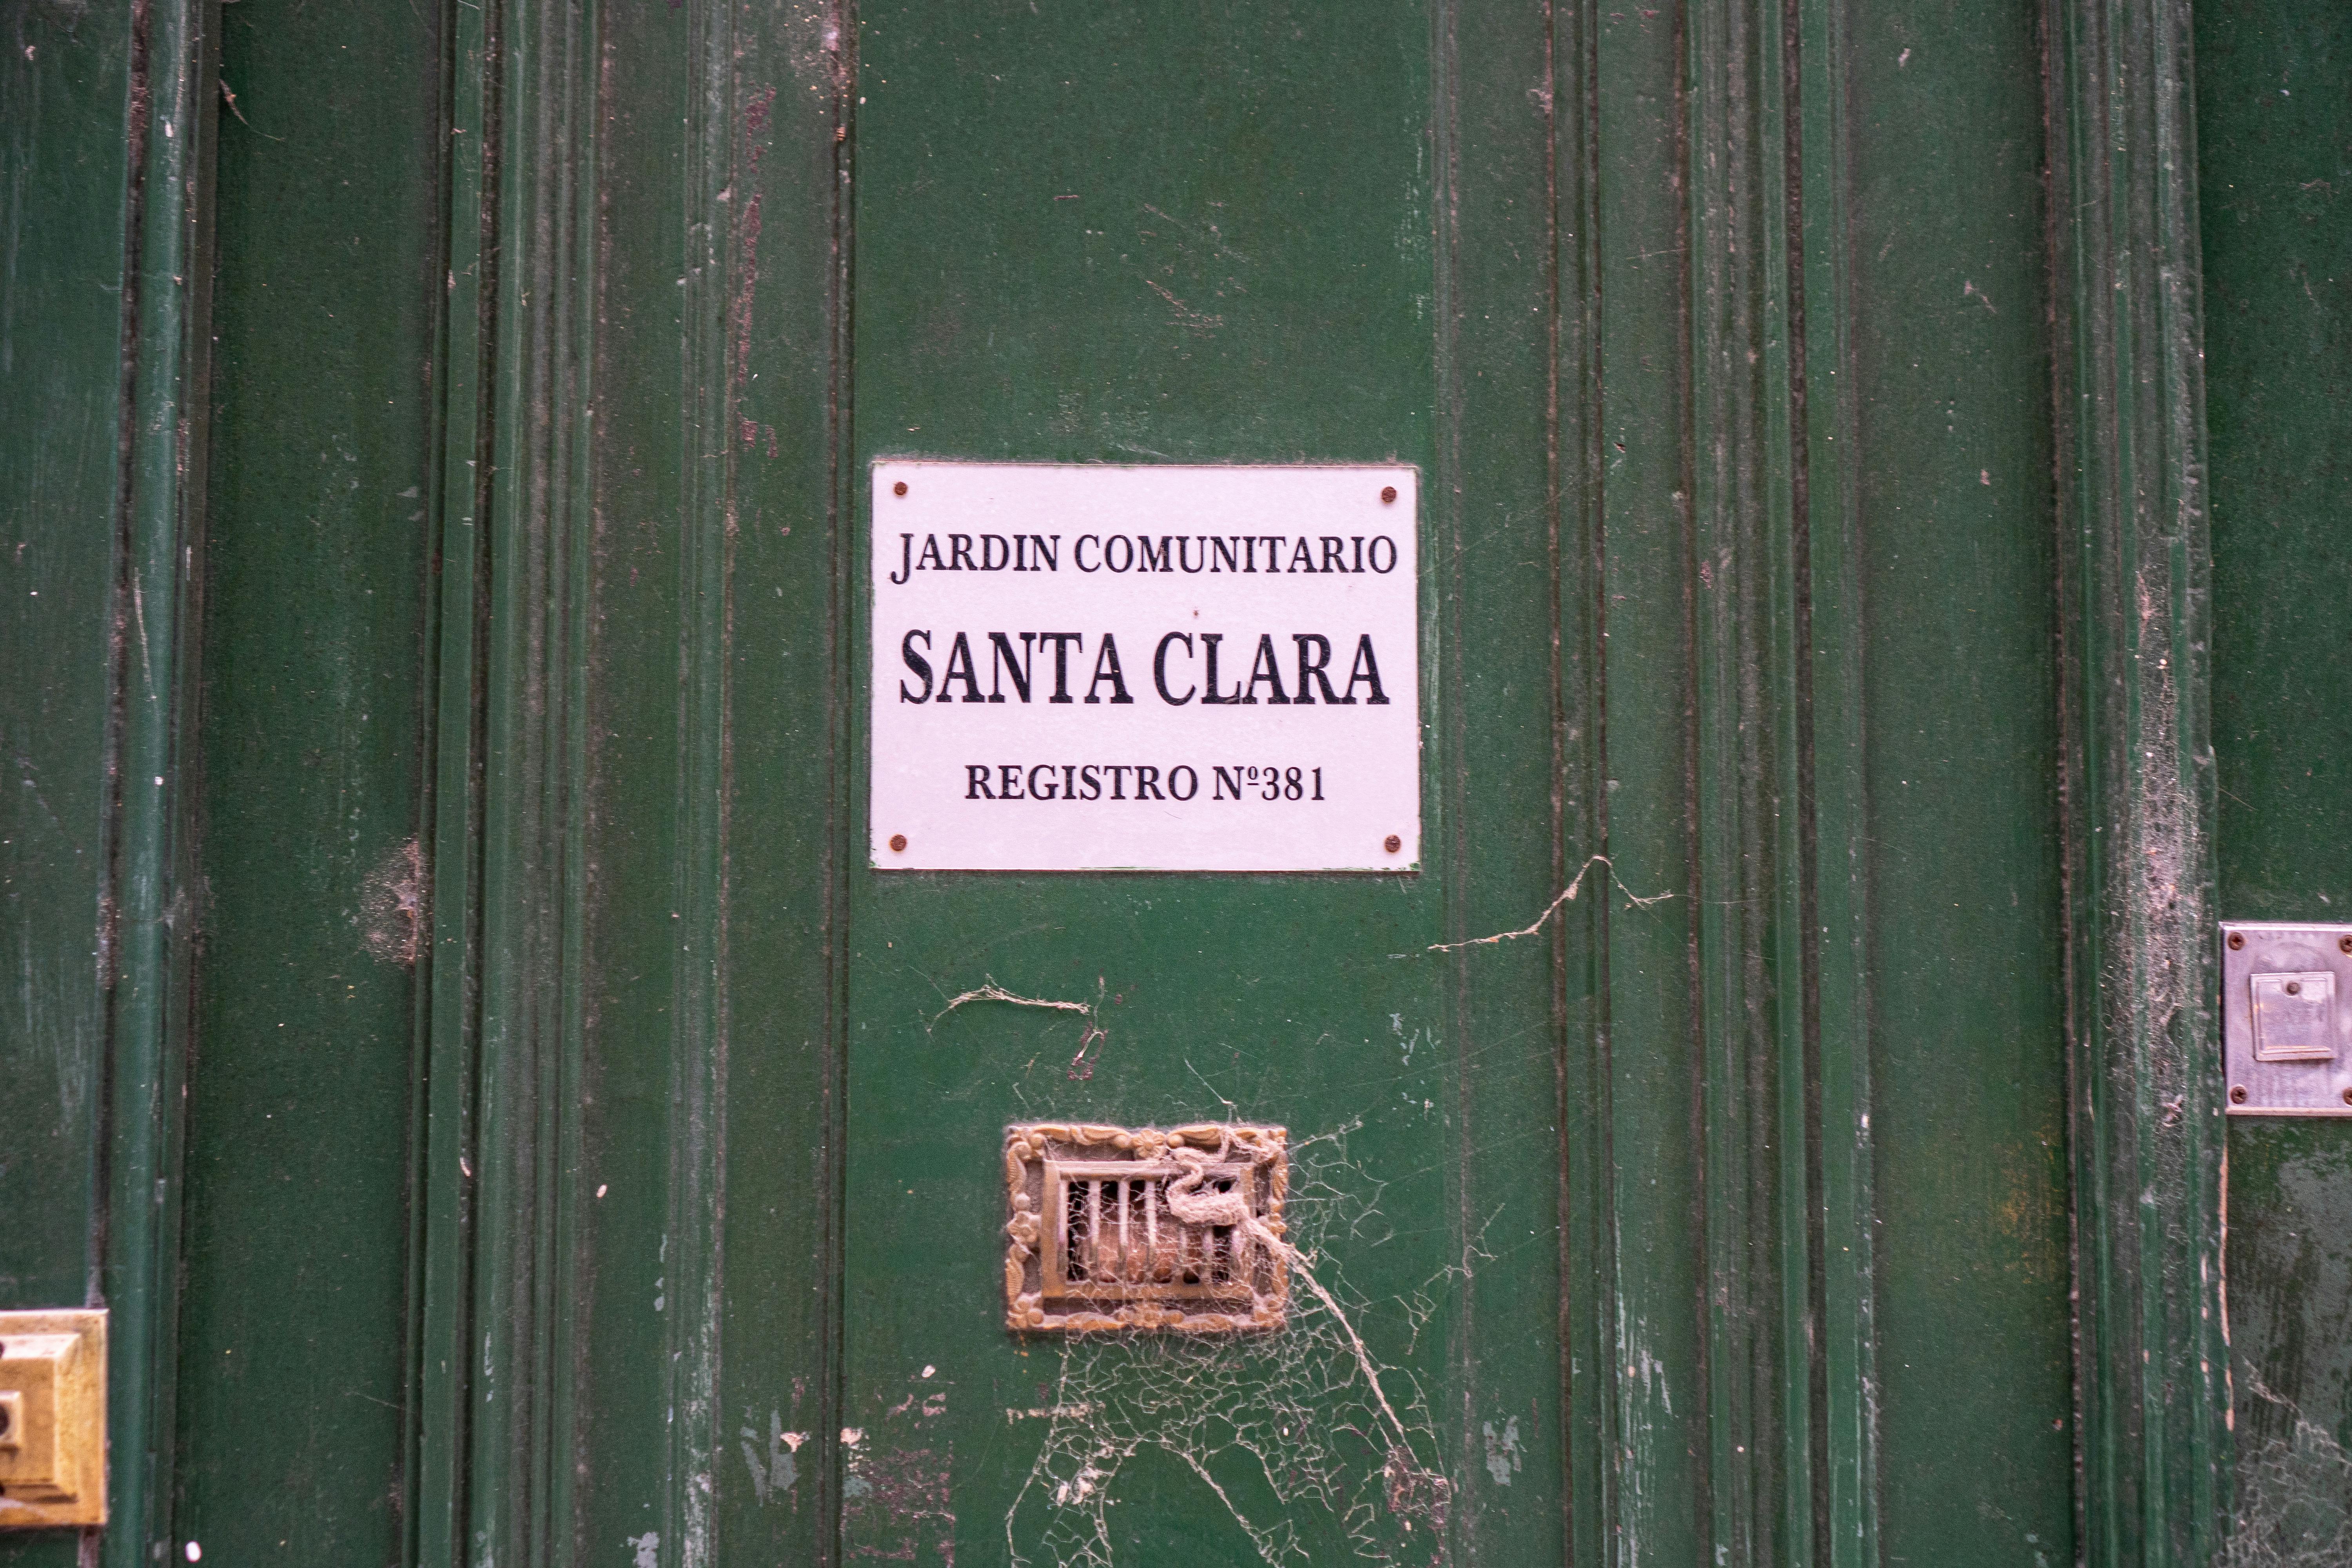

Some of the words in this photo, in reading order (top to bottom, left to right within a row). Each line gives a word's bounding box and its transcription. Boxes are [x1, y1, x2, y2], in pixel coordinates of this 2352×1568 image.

[891, 533, 1060, 585] JARDIN
[1074, 535, 1397, 574] COMUNITARIO
[900, 629, 1134, 704] SANTA
[1154, 632, 1390, 705] CLARA
[965, 764, 1198, 801] REGISTRO
